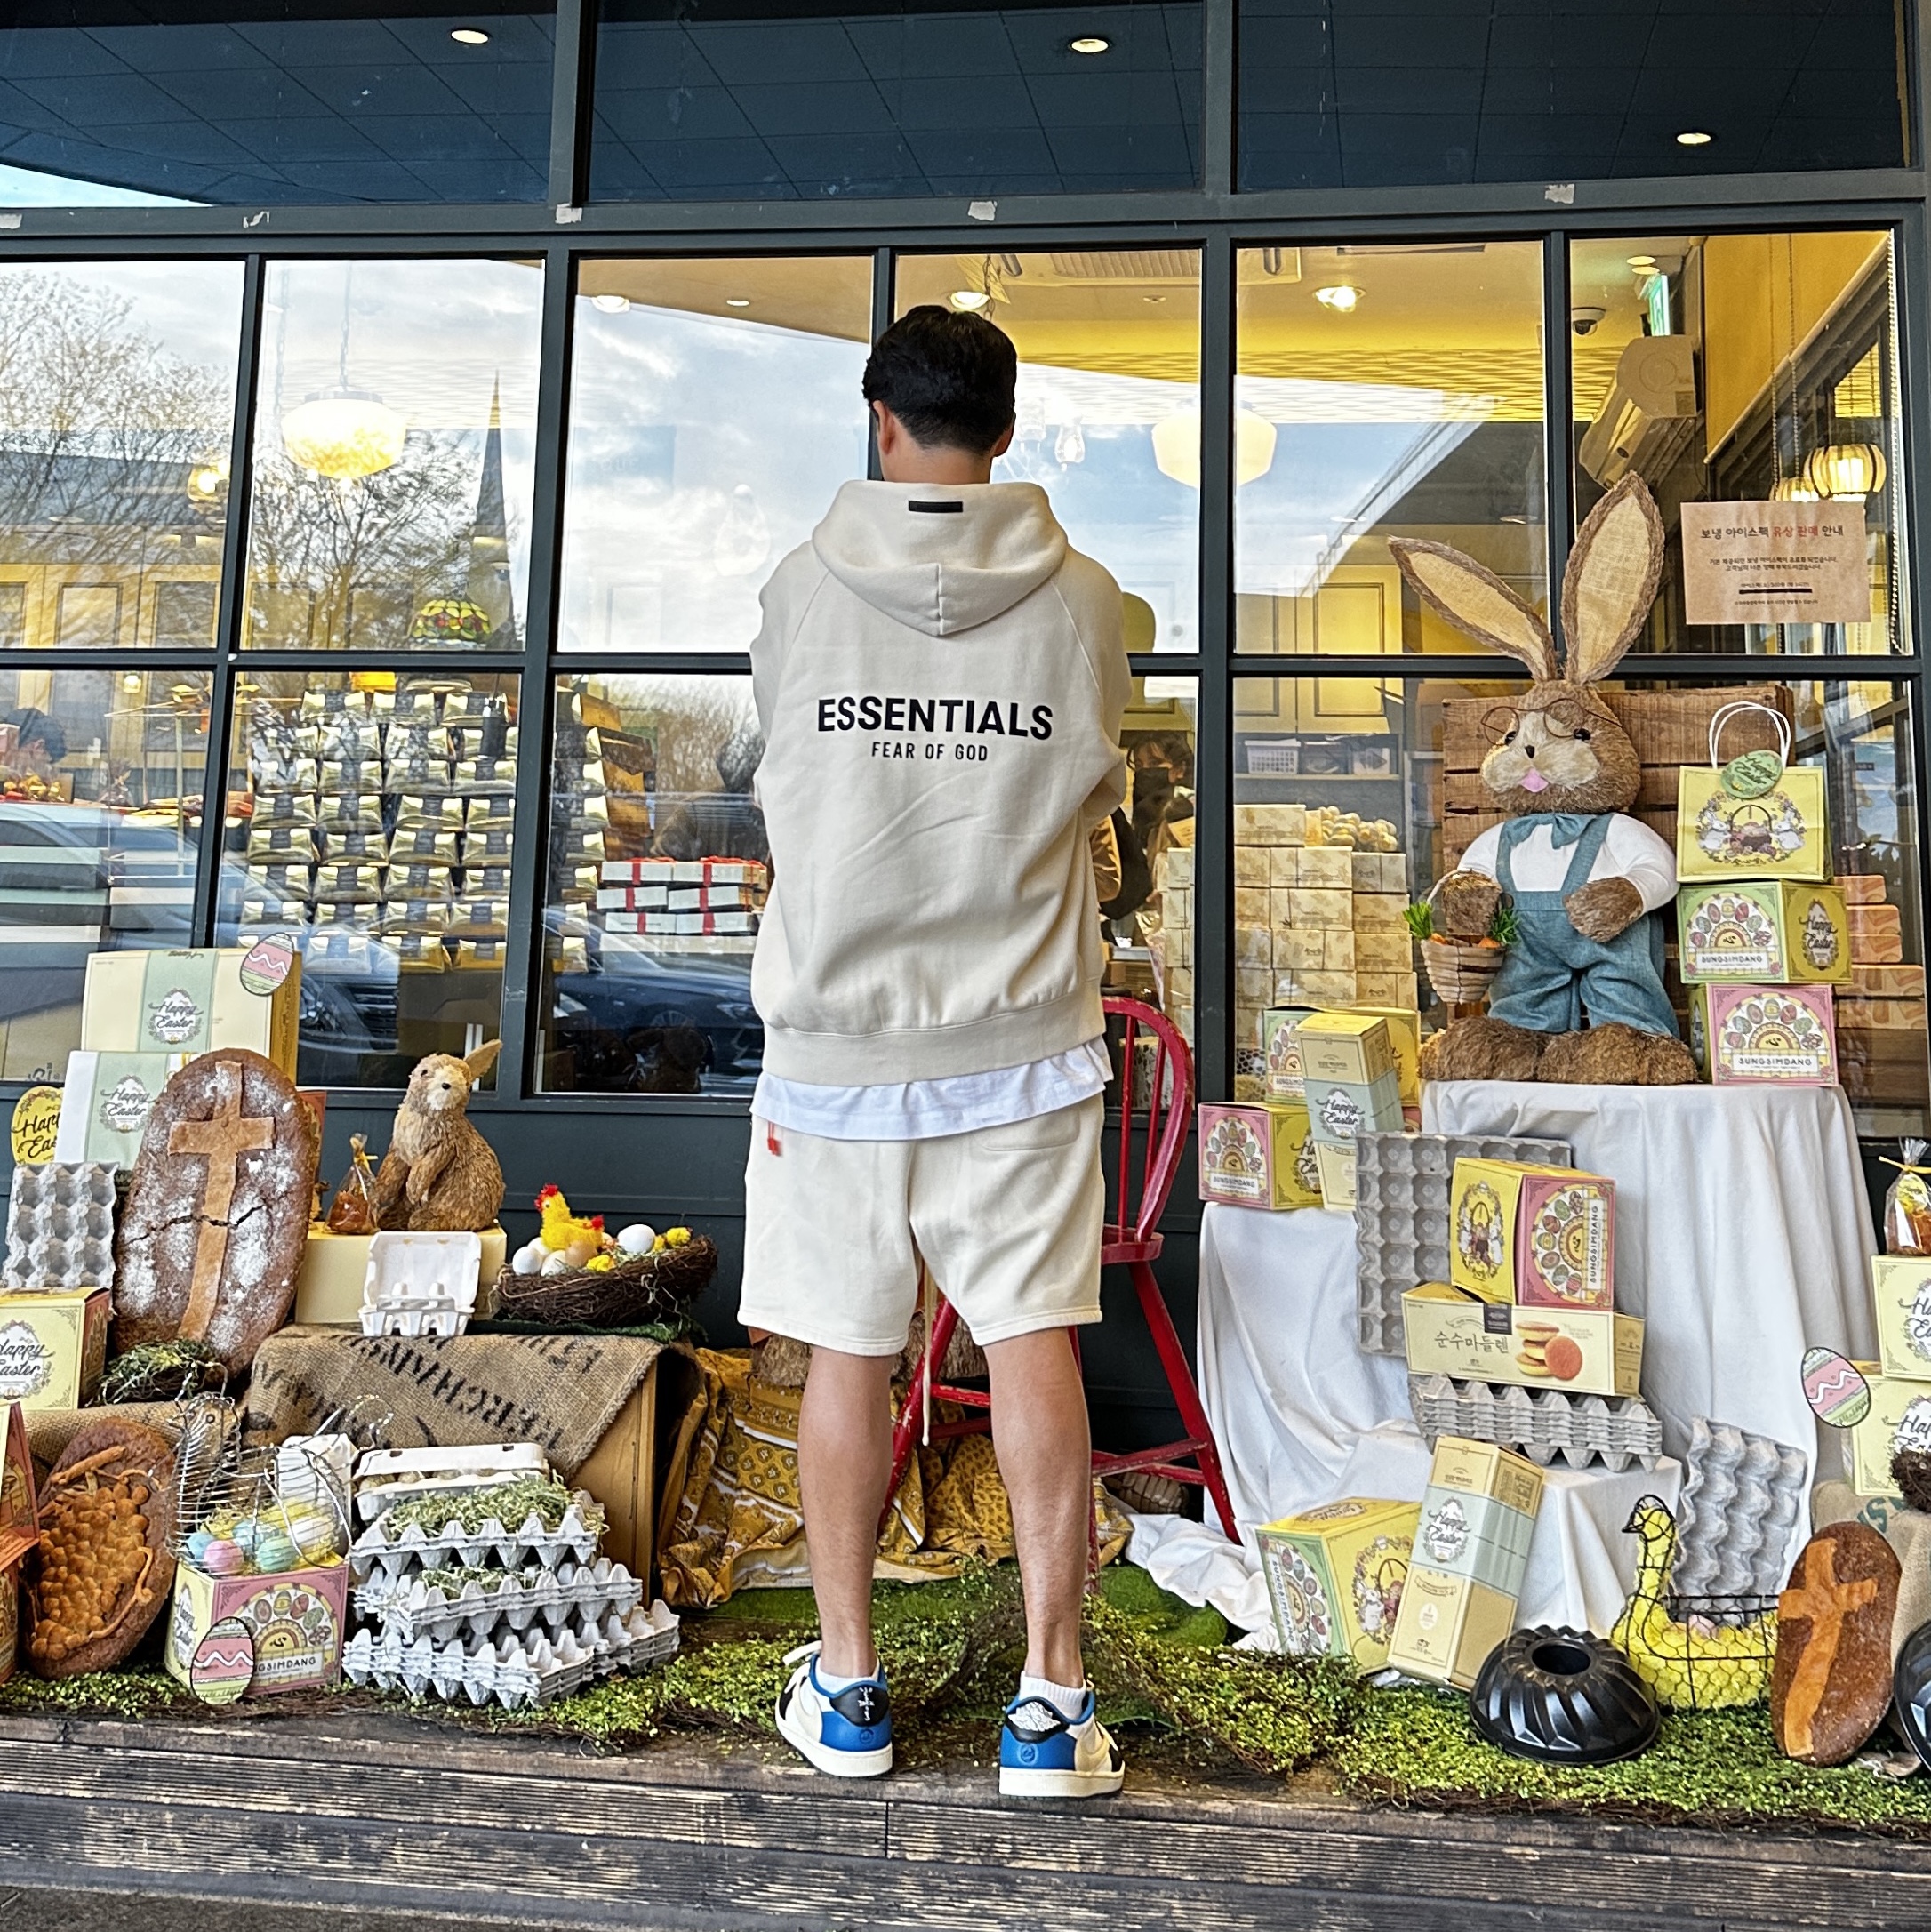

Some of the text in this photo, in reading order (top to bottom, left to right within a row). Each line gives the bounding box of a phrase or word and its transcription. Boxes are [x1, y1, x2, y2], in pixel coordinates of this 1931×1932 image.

[1701, 525, 1844, 540] 보냉 아이스팩 유상 판매 안내
[818, 696, 1053, 740] ESSENTIALS
[871, 742, 988, 761] FEAR OF GOD
[1799, 916, 1838, 934] Happy
[1804, 932, 1834, 949] Easter
[1702, 956, 1762, 964] SUNGSIMDANG
[148, 1001, 204, 1017] Happy
[153, 1014, 194, 1029] Easter
[1738, 1057, 1813, 1066] SUNGSIMDANG
[100, 1088, 156, 1104] Happy
[102, 1102, 147, 1117] Easter
[1315, 1098, 1365, 1116] Happy
[1319, 1110, 1358, 1125] Easter
[1589, 1205, 1598, 1284] SUNGSIMDANG
[1434, 1331, 1509, 1353] 순수마들렌
[0, 1359, 41, 1376] aster
[1427, 1510, 1471, 1532] Happy
[1425, 1523, 1462, 1544] Easter
